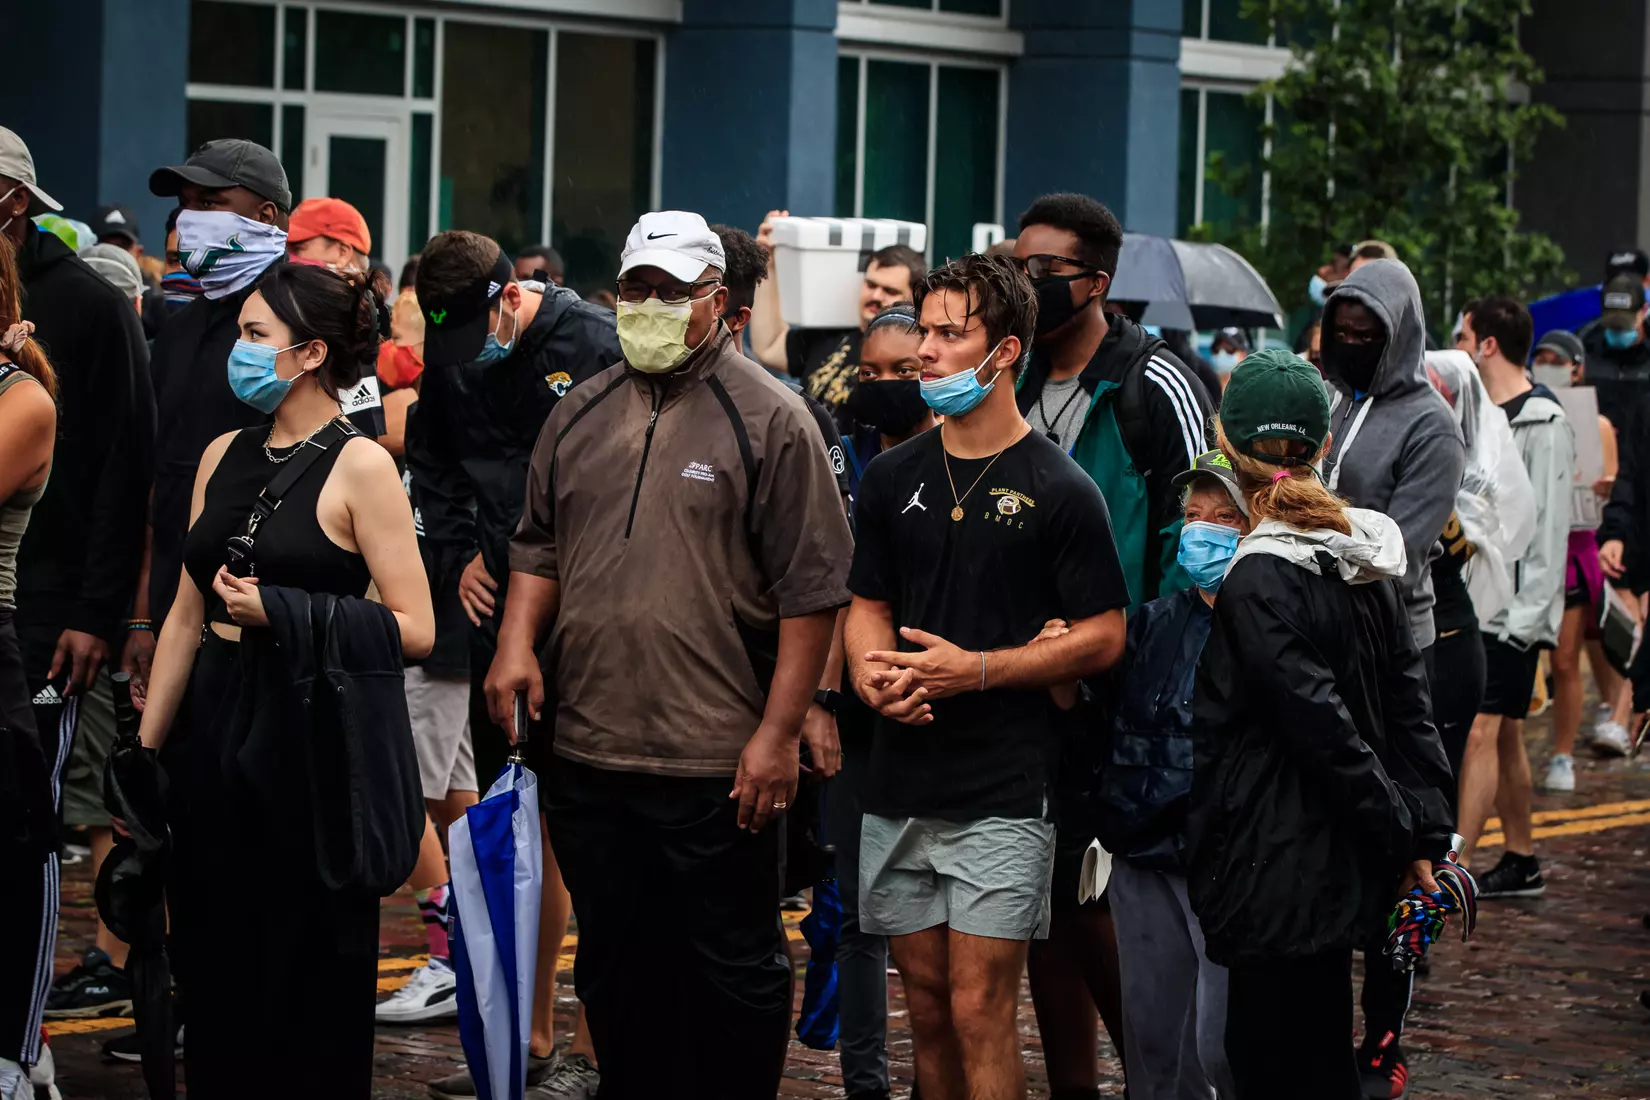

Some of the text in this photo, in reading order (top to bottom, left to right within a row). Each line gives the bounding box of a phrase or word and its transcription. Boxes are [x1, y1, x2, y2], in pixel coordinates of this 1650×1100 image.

[352, 394, 376, 407] adidas
[1256, 423, 1270, 433] NEW
[1270, 422, 1298, 433] ORLEANS,
[1009, 489, 1035, 505] PANTHERS
[85, 986, 109, 994] FILA
